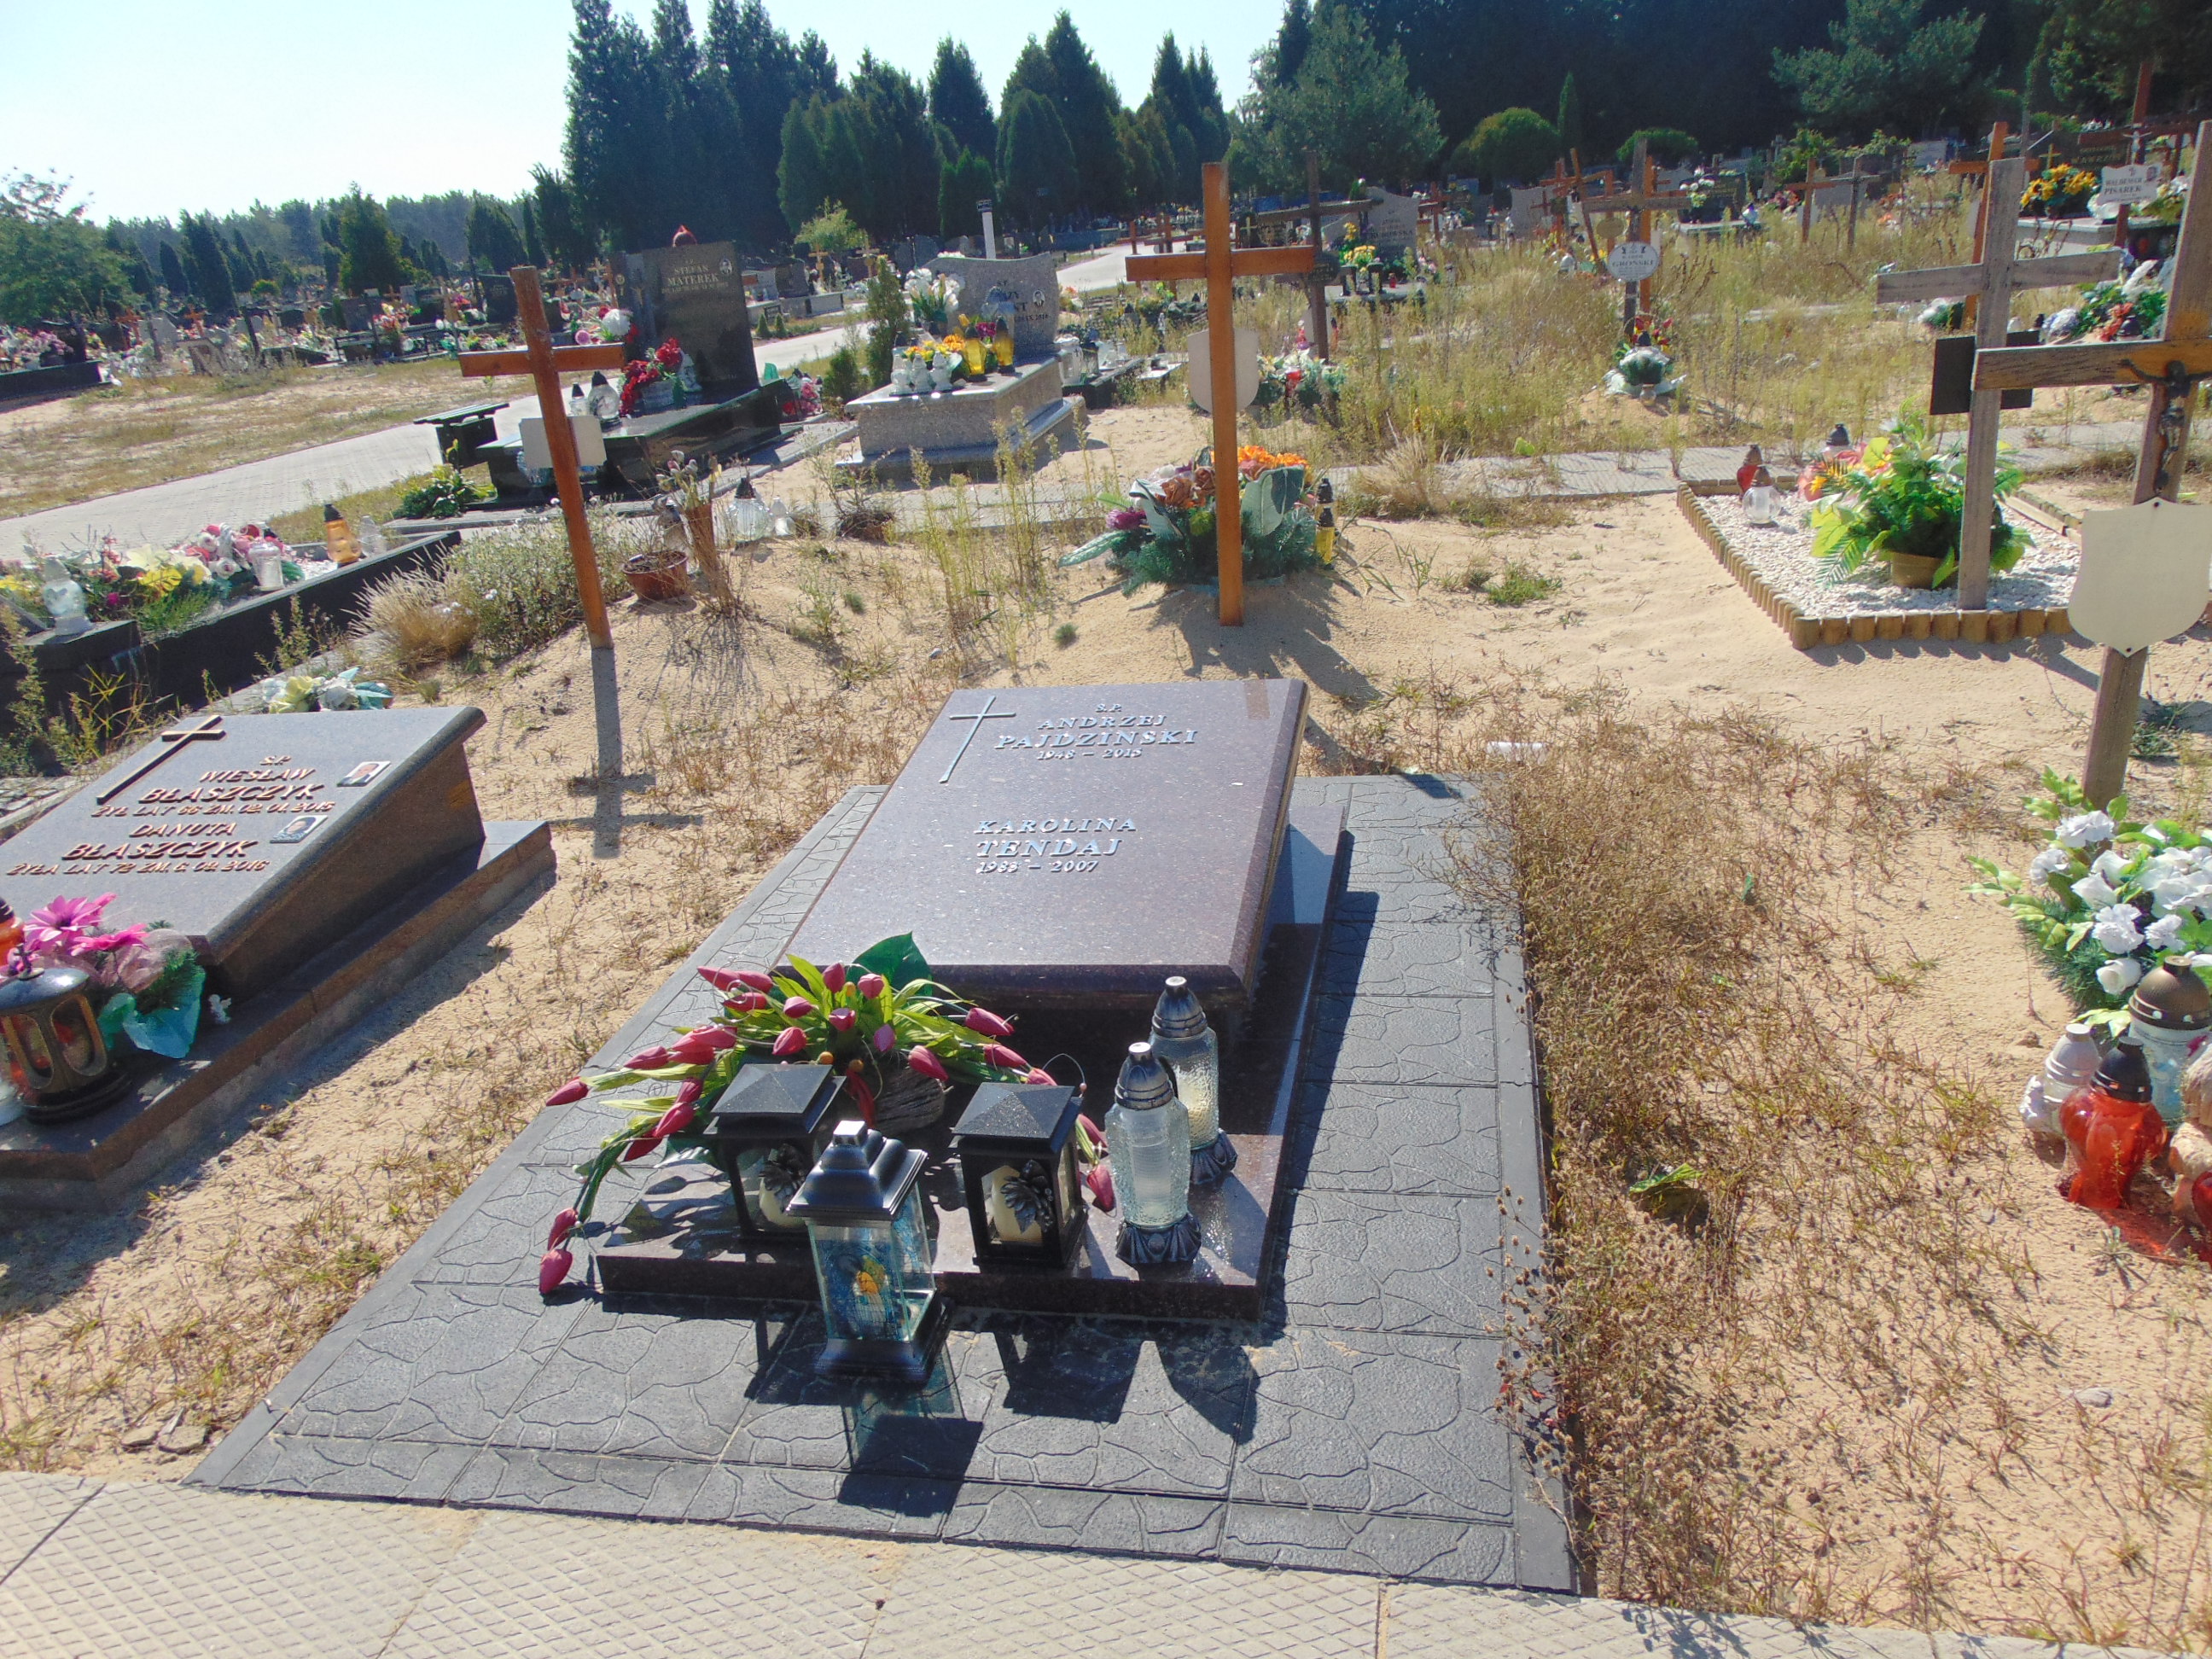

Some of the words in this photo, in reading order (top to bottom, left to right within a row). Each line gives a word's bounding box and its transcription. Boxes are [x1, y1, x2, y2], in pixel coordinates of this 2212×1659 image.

[1038, 715, 1167, 730] ANDRZEJ
[994, 730, 1197, 749] PAJDZINSKI
[1037, 749, 1075, 760] 1948
[1103, 748, 1142, 759] 2015
[200, 769, 316, 783] WIESŁAW
[138, 783, 325, 804] BŁASZCZYK
[132, 806, 176, 817] LAT
[178, 806, 203, 815] 66
[202, 805, 234, 816] ZM.
[290, 800, 336, 812] 2015
[129, 823, 238, 837] DANUTA
[974, 818, 1136, 834] KAROLINA
[61, 841, 259, 860] BŁASZCZYK
[975, 838, 1123, 858] TENDAJ
[63, 863, 110, 875] LAT
[137, 862, 169, 874] ZM.
[221, 859, 271, 871] 2016
[1050, 860, 1099, 872] 2007
